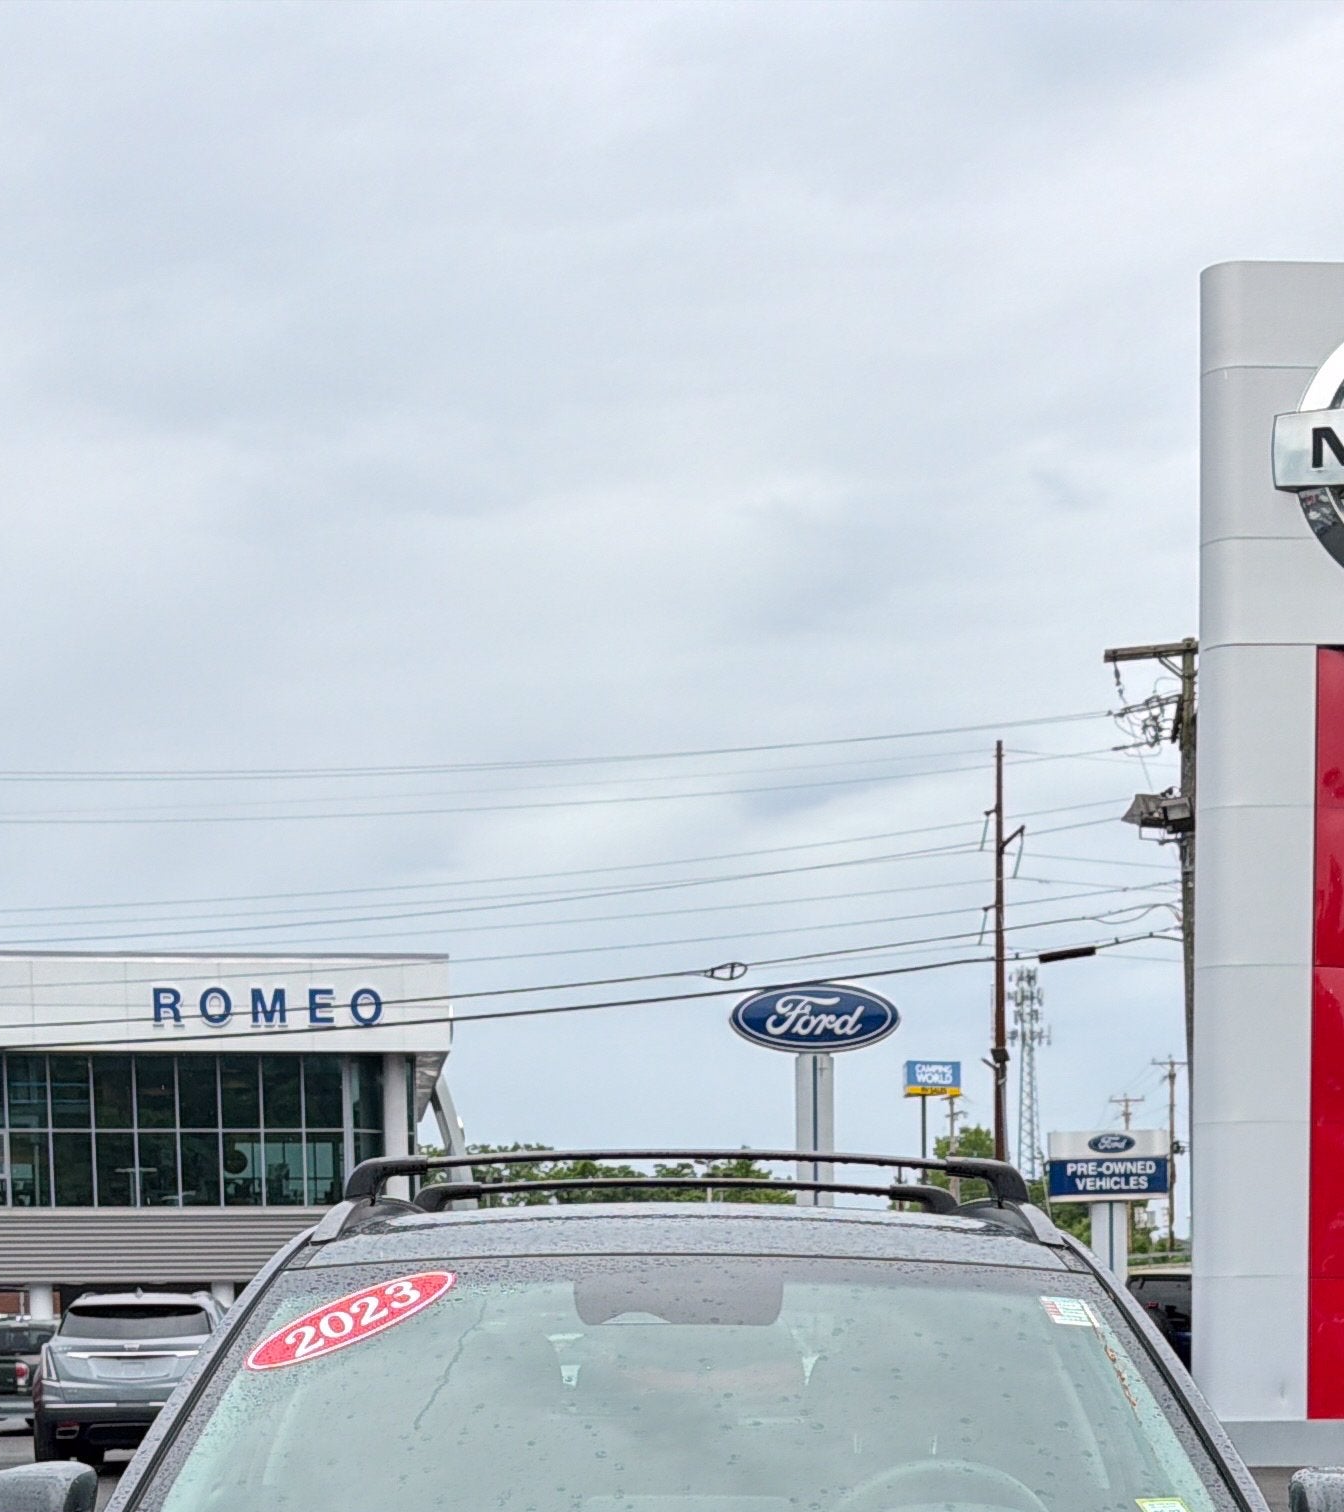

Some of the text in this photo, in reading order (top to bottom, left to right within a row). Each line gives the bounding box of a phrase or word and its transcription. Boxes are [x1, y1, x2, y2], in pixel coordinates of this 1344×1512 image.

[152, 986, 383, 1027] ROMEO
[765, 994, 865, 1036] Ford
[916, 1072, 953, 1085] WORLD
[1098, 1136, 1127, 1150] Ford
[1066, 1160, 1156, 1177] PRE-OWNED
[1075, 1175, 1149, 1191] VEHICLES
[285, 1281, 422, 1358] 2023
